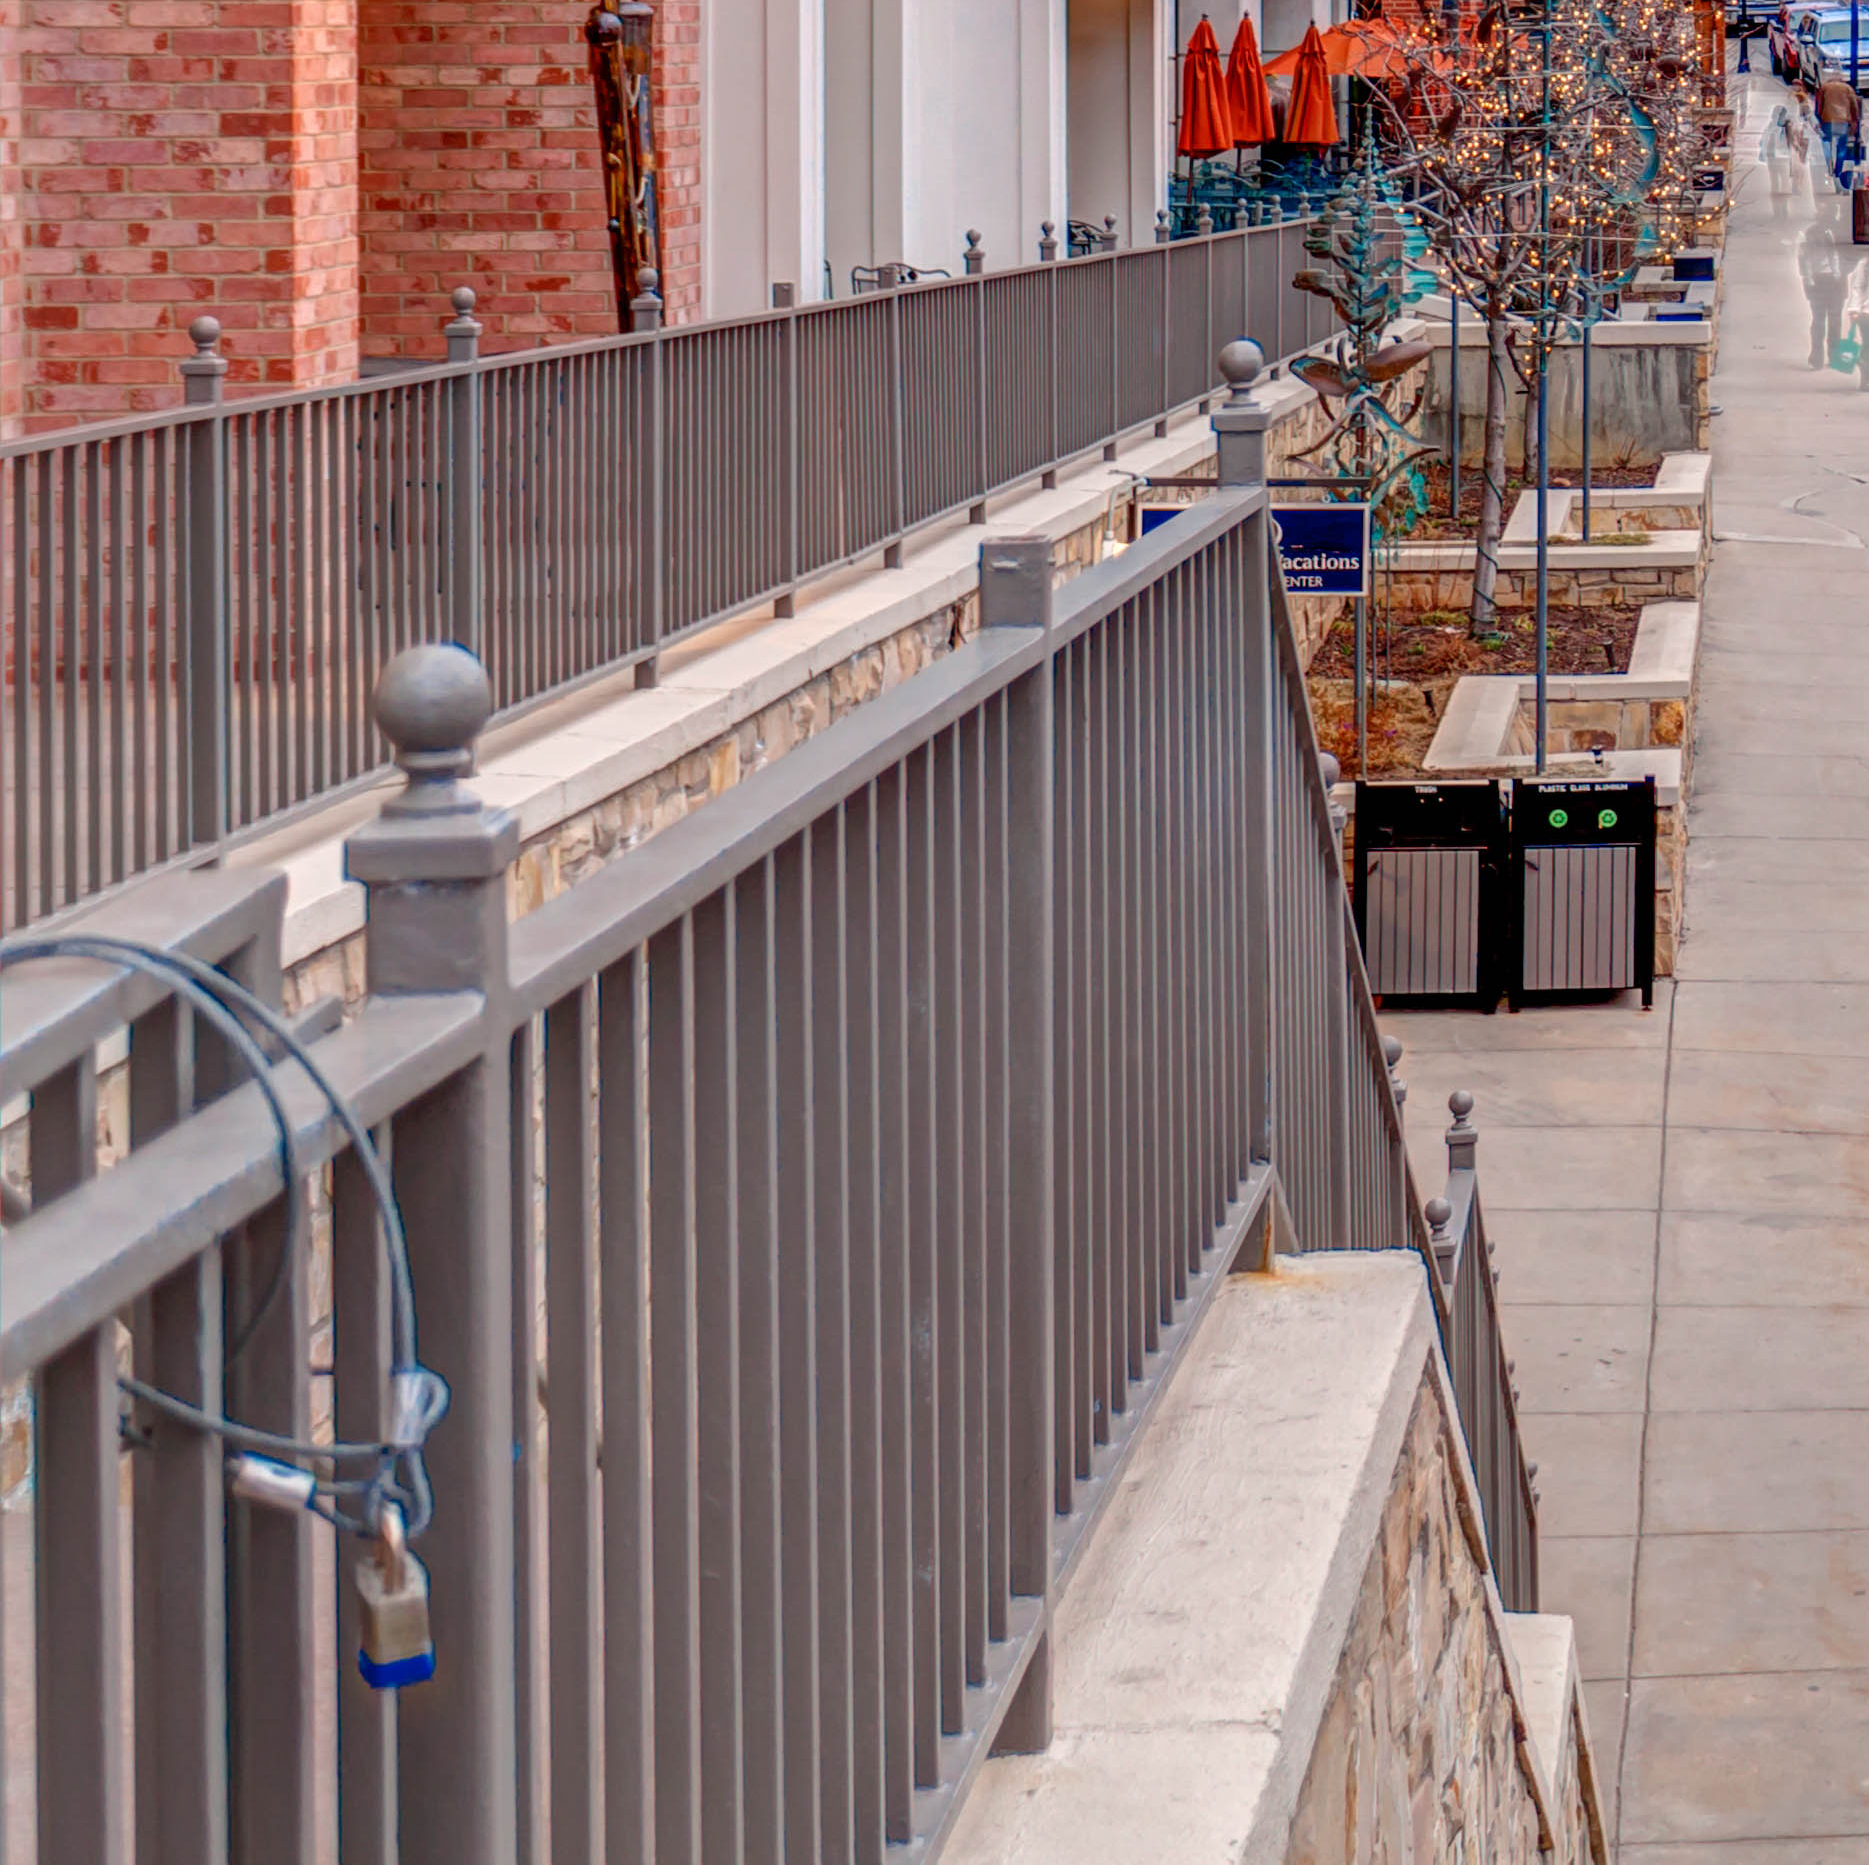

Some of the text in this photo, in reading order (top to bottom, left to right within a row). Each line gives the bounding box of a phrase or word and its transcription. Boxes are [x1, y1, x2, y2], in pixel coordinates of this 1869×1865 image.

[1284, 575, 1324, 588] ENTER
[1415, 786, 1438, 794] TRASH
[1538, 785, 1567, 793] PLASTIC
[1570, 784, 1591, 792] GLASS
